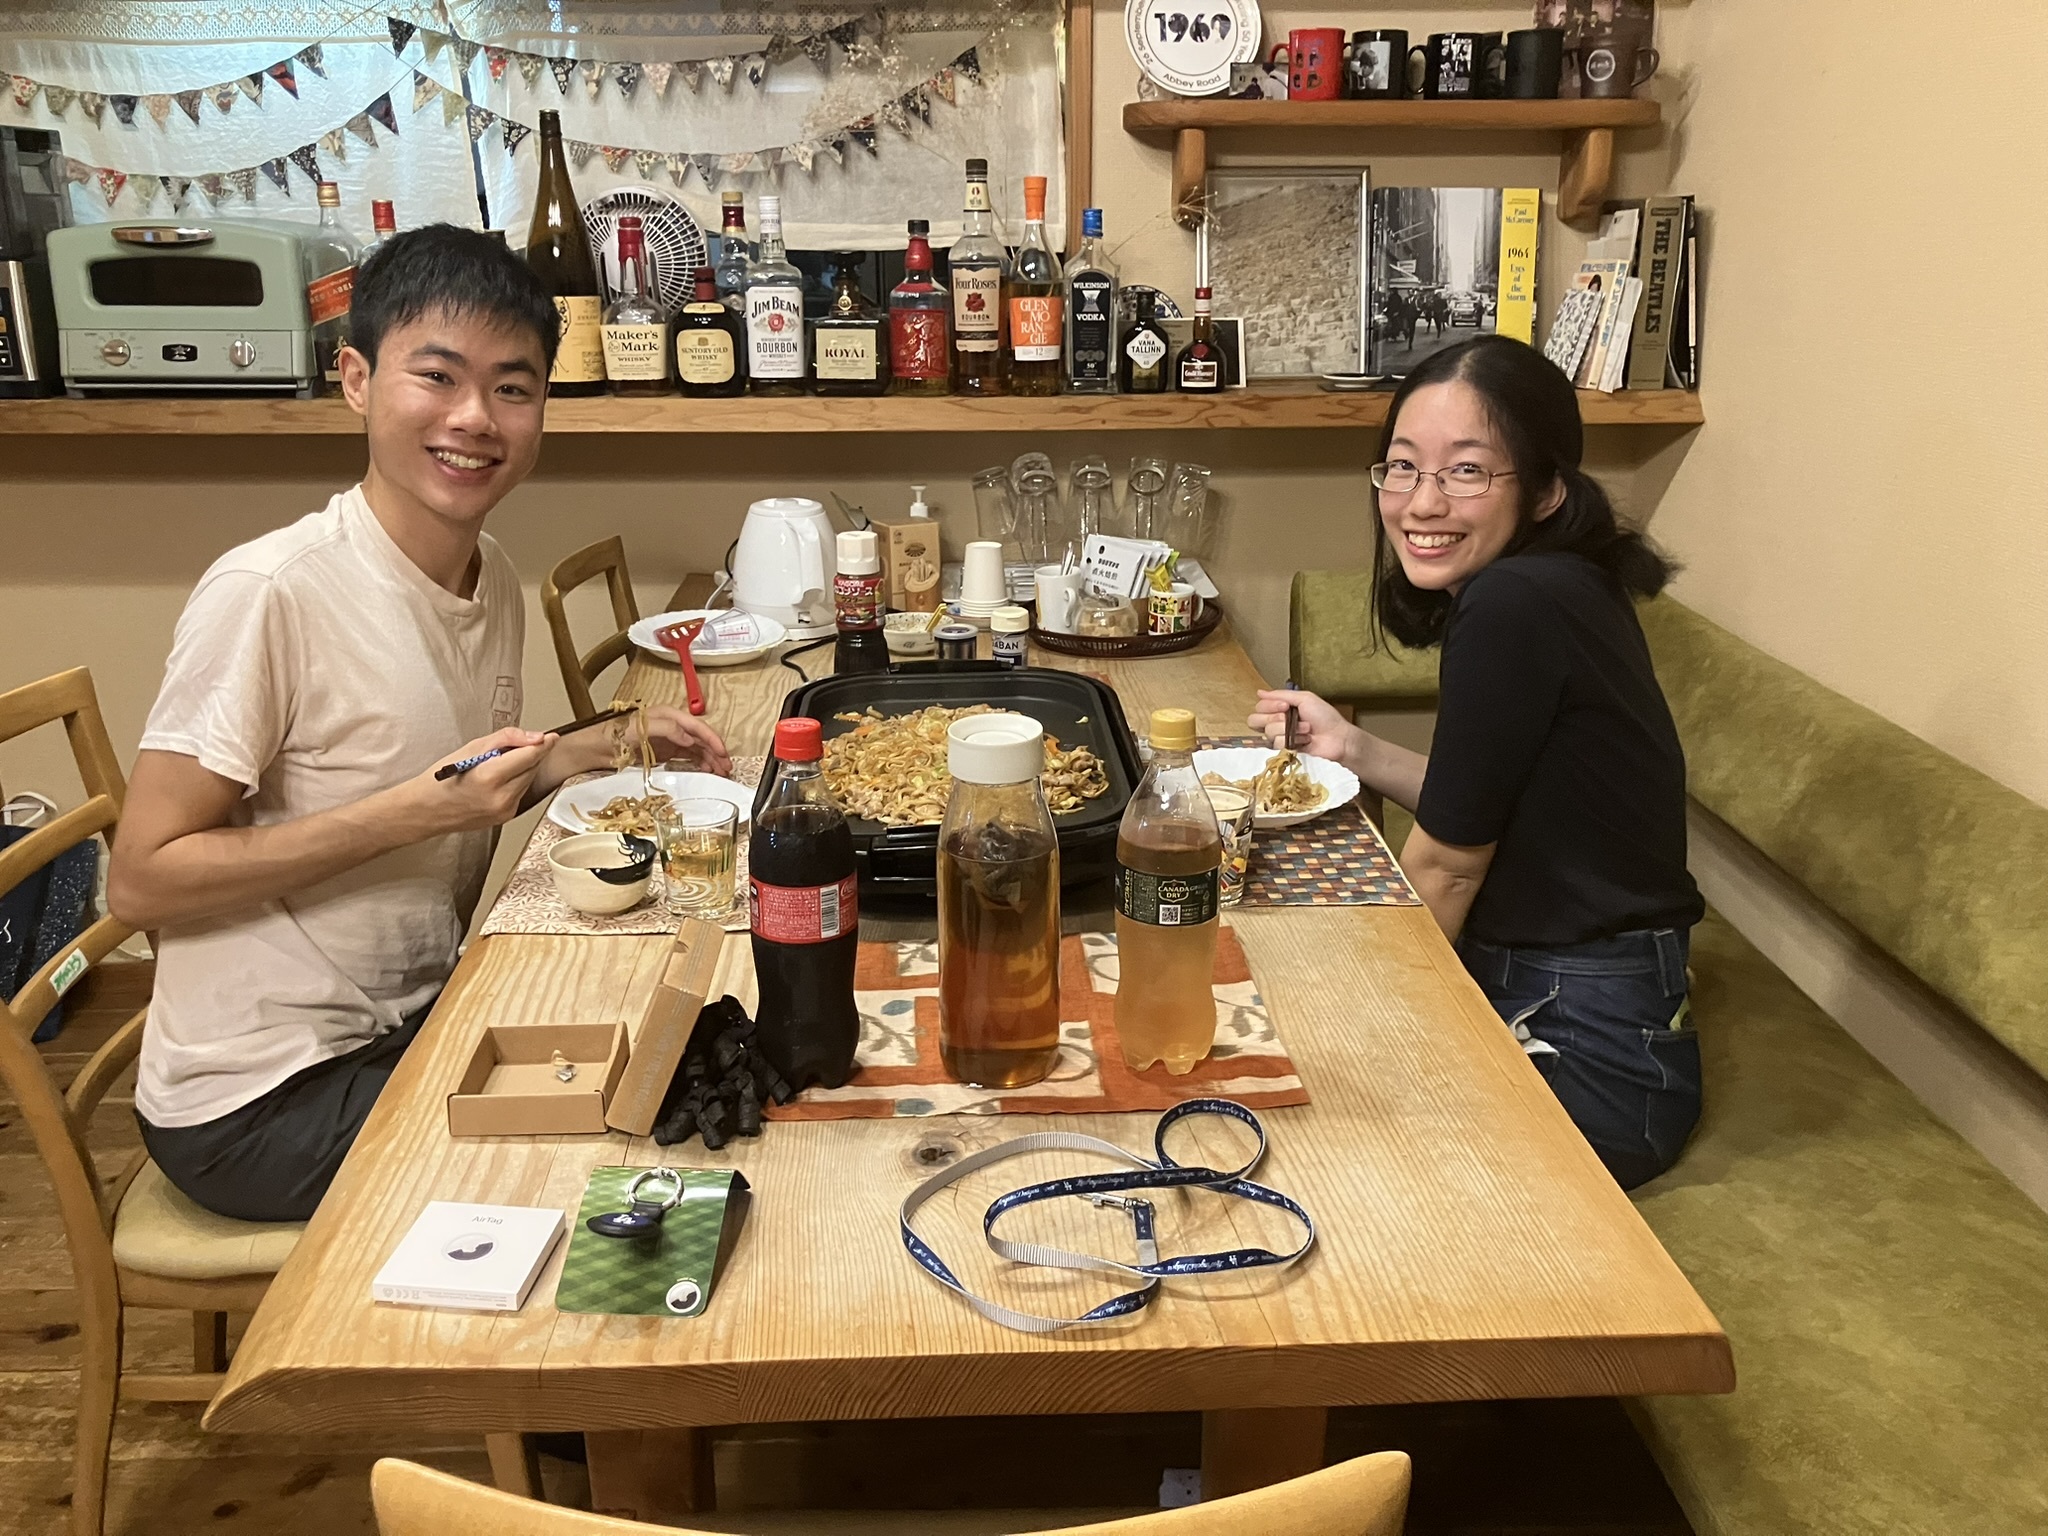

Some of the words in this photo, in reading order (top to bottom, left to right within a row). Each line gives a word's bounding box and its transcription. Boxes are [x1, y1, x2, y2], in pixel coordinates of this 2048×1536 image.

[1154, 12, 1232, 43] 1969
[1163, 73, 1194, 88] Abbey
[1196, 75, 1222, 87] Road
[1653, 218, 1672, 255] THE
[955, 277, 971, 290] Four
[972, 277, 997, 290] Roses
[1645, 258, 1668, 334] BEATLES
[751, 300, 771, 319] JIM
[771, 295, 800, 318] BEAM
[1020, 299, 1049, 311] GLEN
[1031, 310, 1051, 323] MO
[1076, 313, 1106, 321] VODKA
[1020, 322, 1043, 334] RAN
[607, 330, 659, 341] Maker's
[1030, 333, 1048, 345] GIE
[621, 341, 658, 352] Mark
[756, 342, 798, 353] BOURBON
[472, 1215, 503, 1225] AirTag
